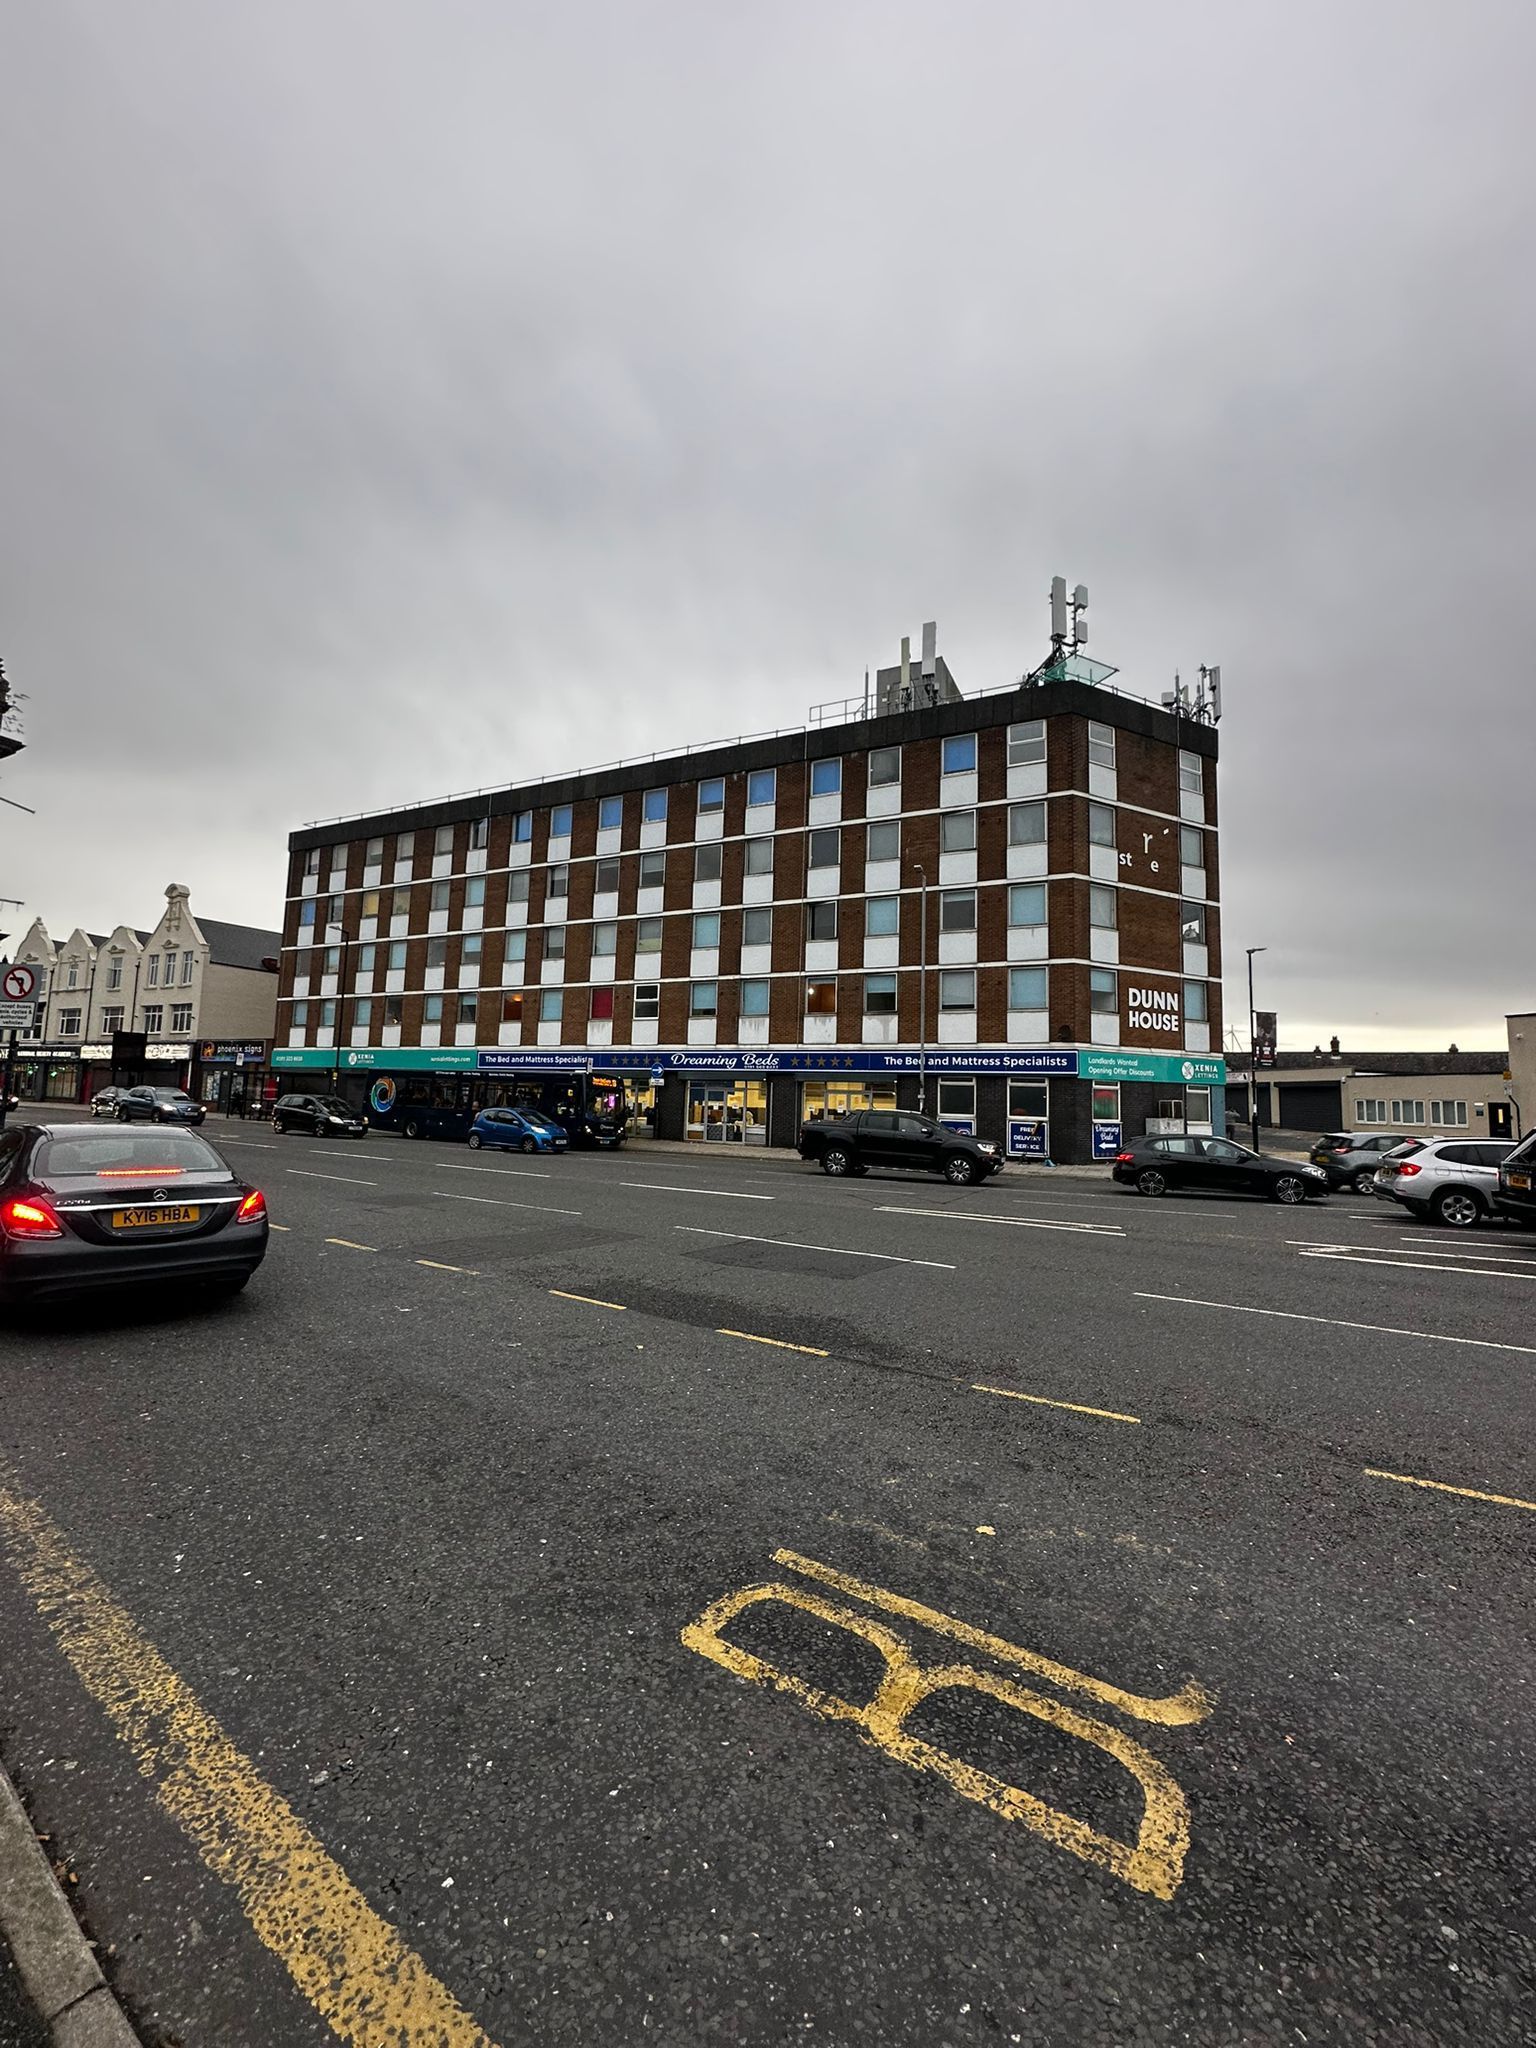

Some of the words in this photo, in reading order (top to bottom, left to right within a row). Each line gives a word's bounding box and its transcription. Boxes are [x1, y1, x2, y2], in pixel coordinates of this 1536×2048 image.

[1128, 987, 1179, 1012] DUNN
[1128, 1010, 1179, 1032] HOUSE
[217, 1044, 242, 1053] phoenix
[244, 1044, 262, 1054] signs
[670, 1053, 738, 1069] Dreaming
[741, 1053, 780, 1066] Beds
[884, 1056, 903, 1066] The
[927, 1056, 949, 1066] and
[952, 1056, 1001, 1066] Mattress
[1002, 1056, 1068, 1067] Specialists
[1117, 1058, 1138, 1066] Wanted
[1088, 1066, 1112, 1075] Opening
[1113, 1067, 1128, 1075] Offer
[1128, 1068, 1155, 1076] Discounts
[1194, 1064, 1218, 1073] XENIA
[123, 1209, 158, 1225] KY16
[162, 1207, 191, 1221] HBA
